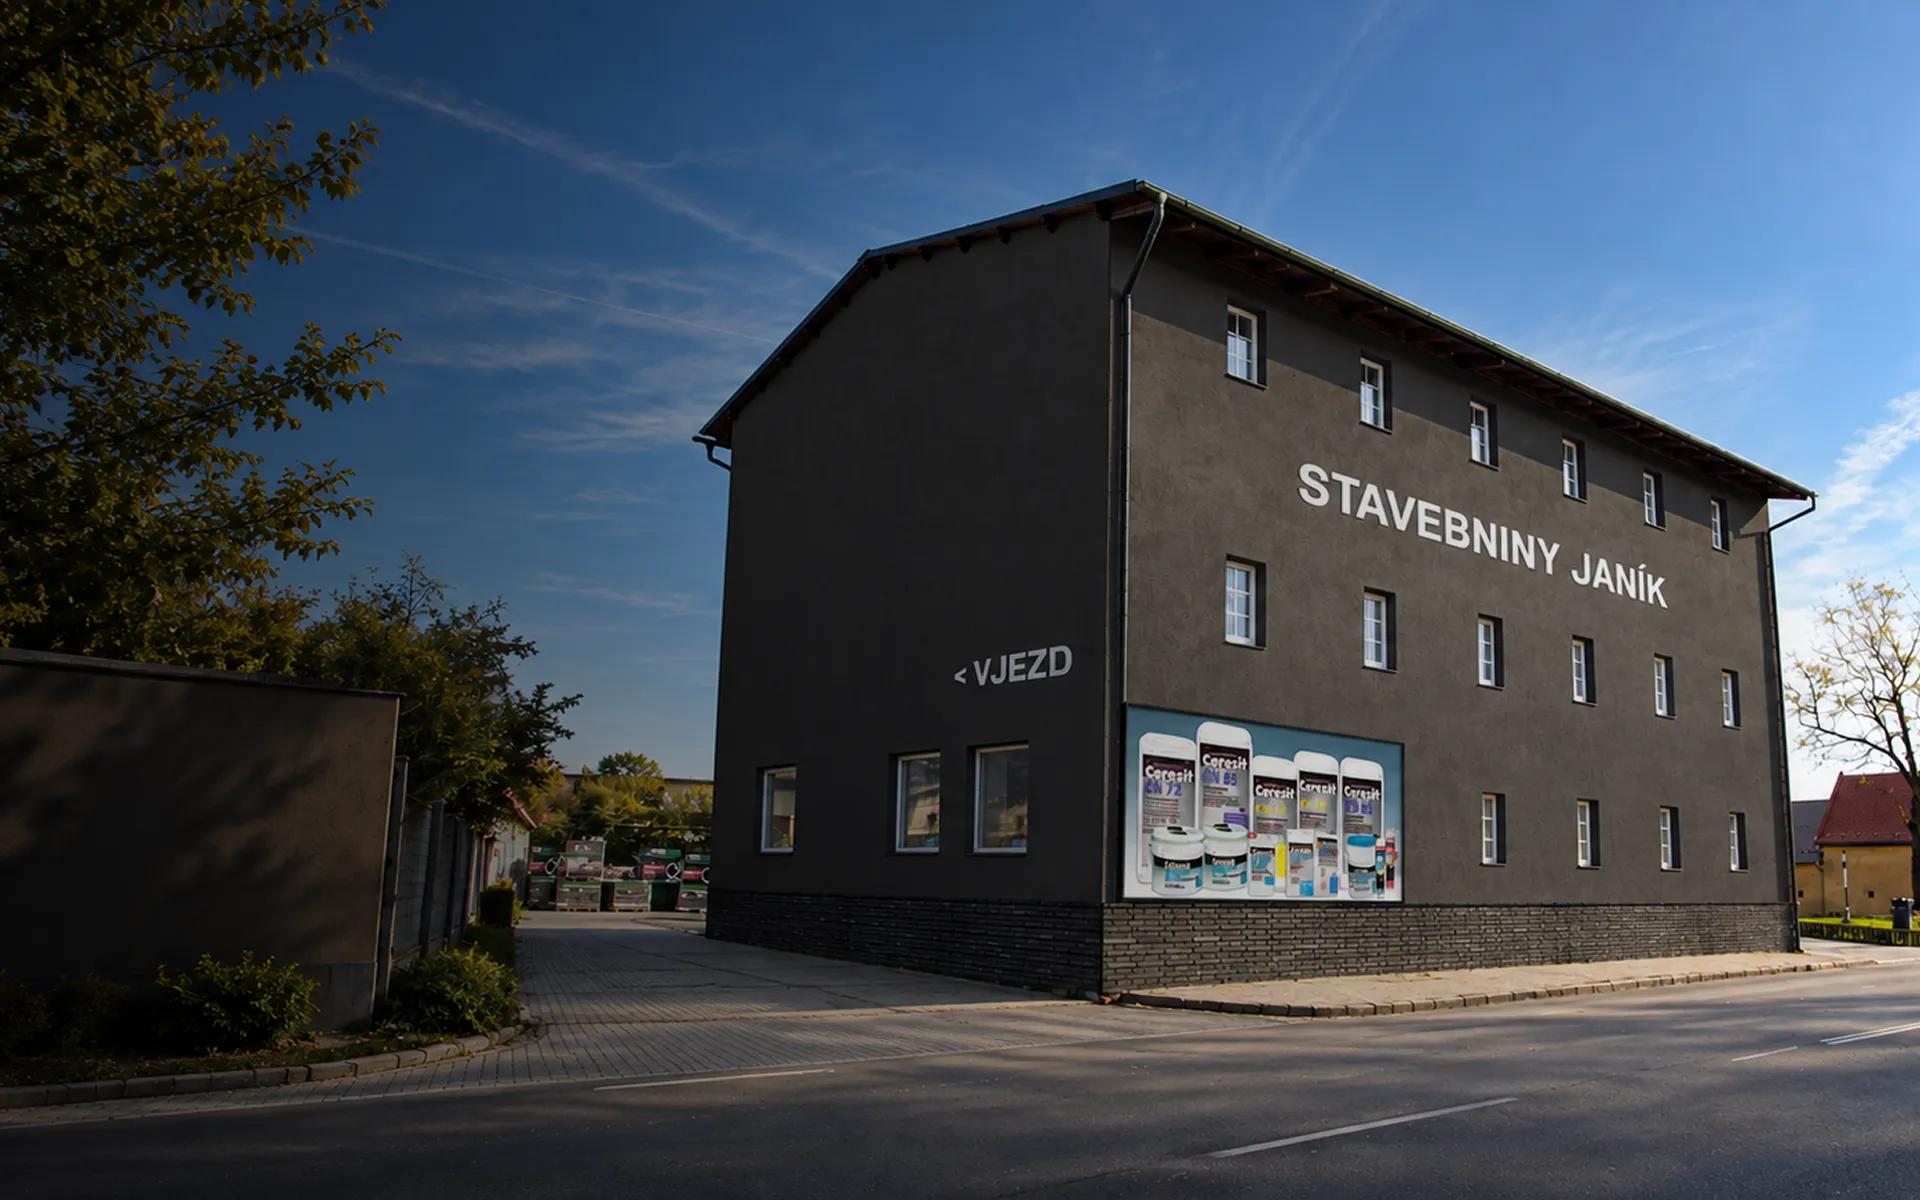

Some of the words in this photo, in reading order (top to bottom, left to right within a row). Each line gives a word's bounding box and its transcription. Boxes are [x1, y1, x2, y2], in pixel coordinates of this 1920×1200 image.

[1299, 463, 1560, 575] STAVEBNINY
[1571, 553, 1668, 609] JANÍK
[973, 645, 1073, 686] VJEZD
